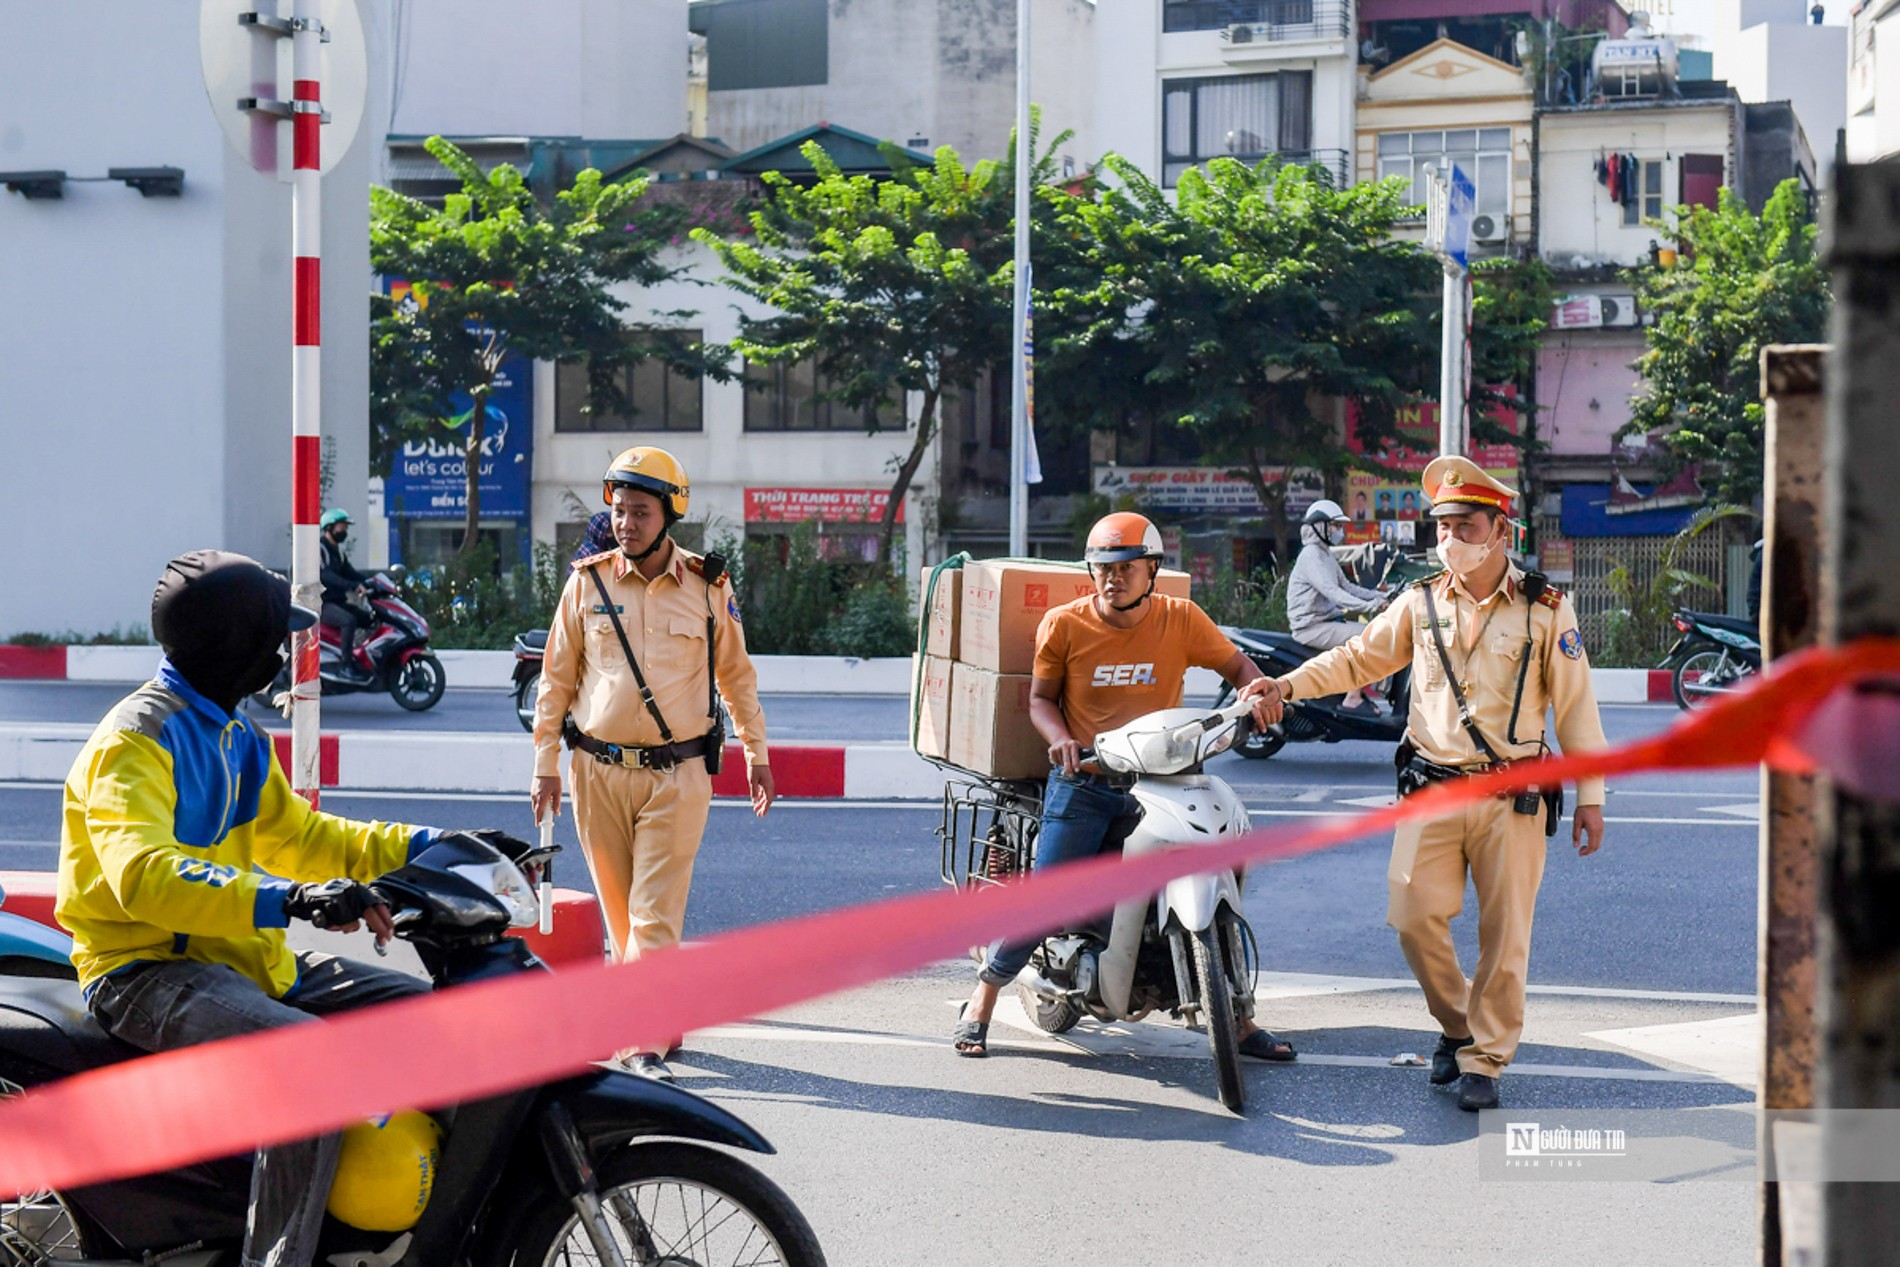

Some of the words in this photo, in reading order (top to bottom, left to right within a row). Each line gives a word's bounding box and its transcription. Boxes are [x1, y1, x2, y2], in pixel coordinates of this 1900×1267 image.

[403, 459, 438, 476] let's
[440, 460, 495, 477] colur
[790, 491, 840, 504] TRANG
